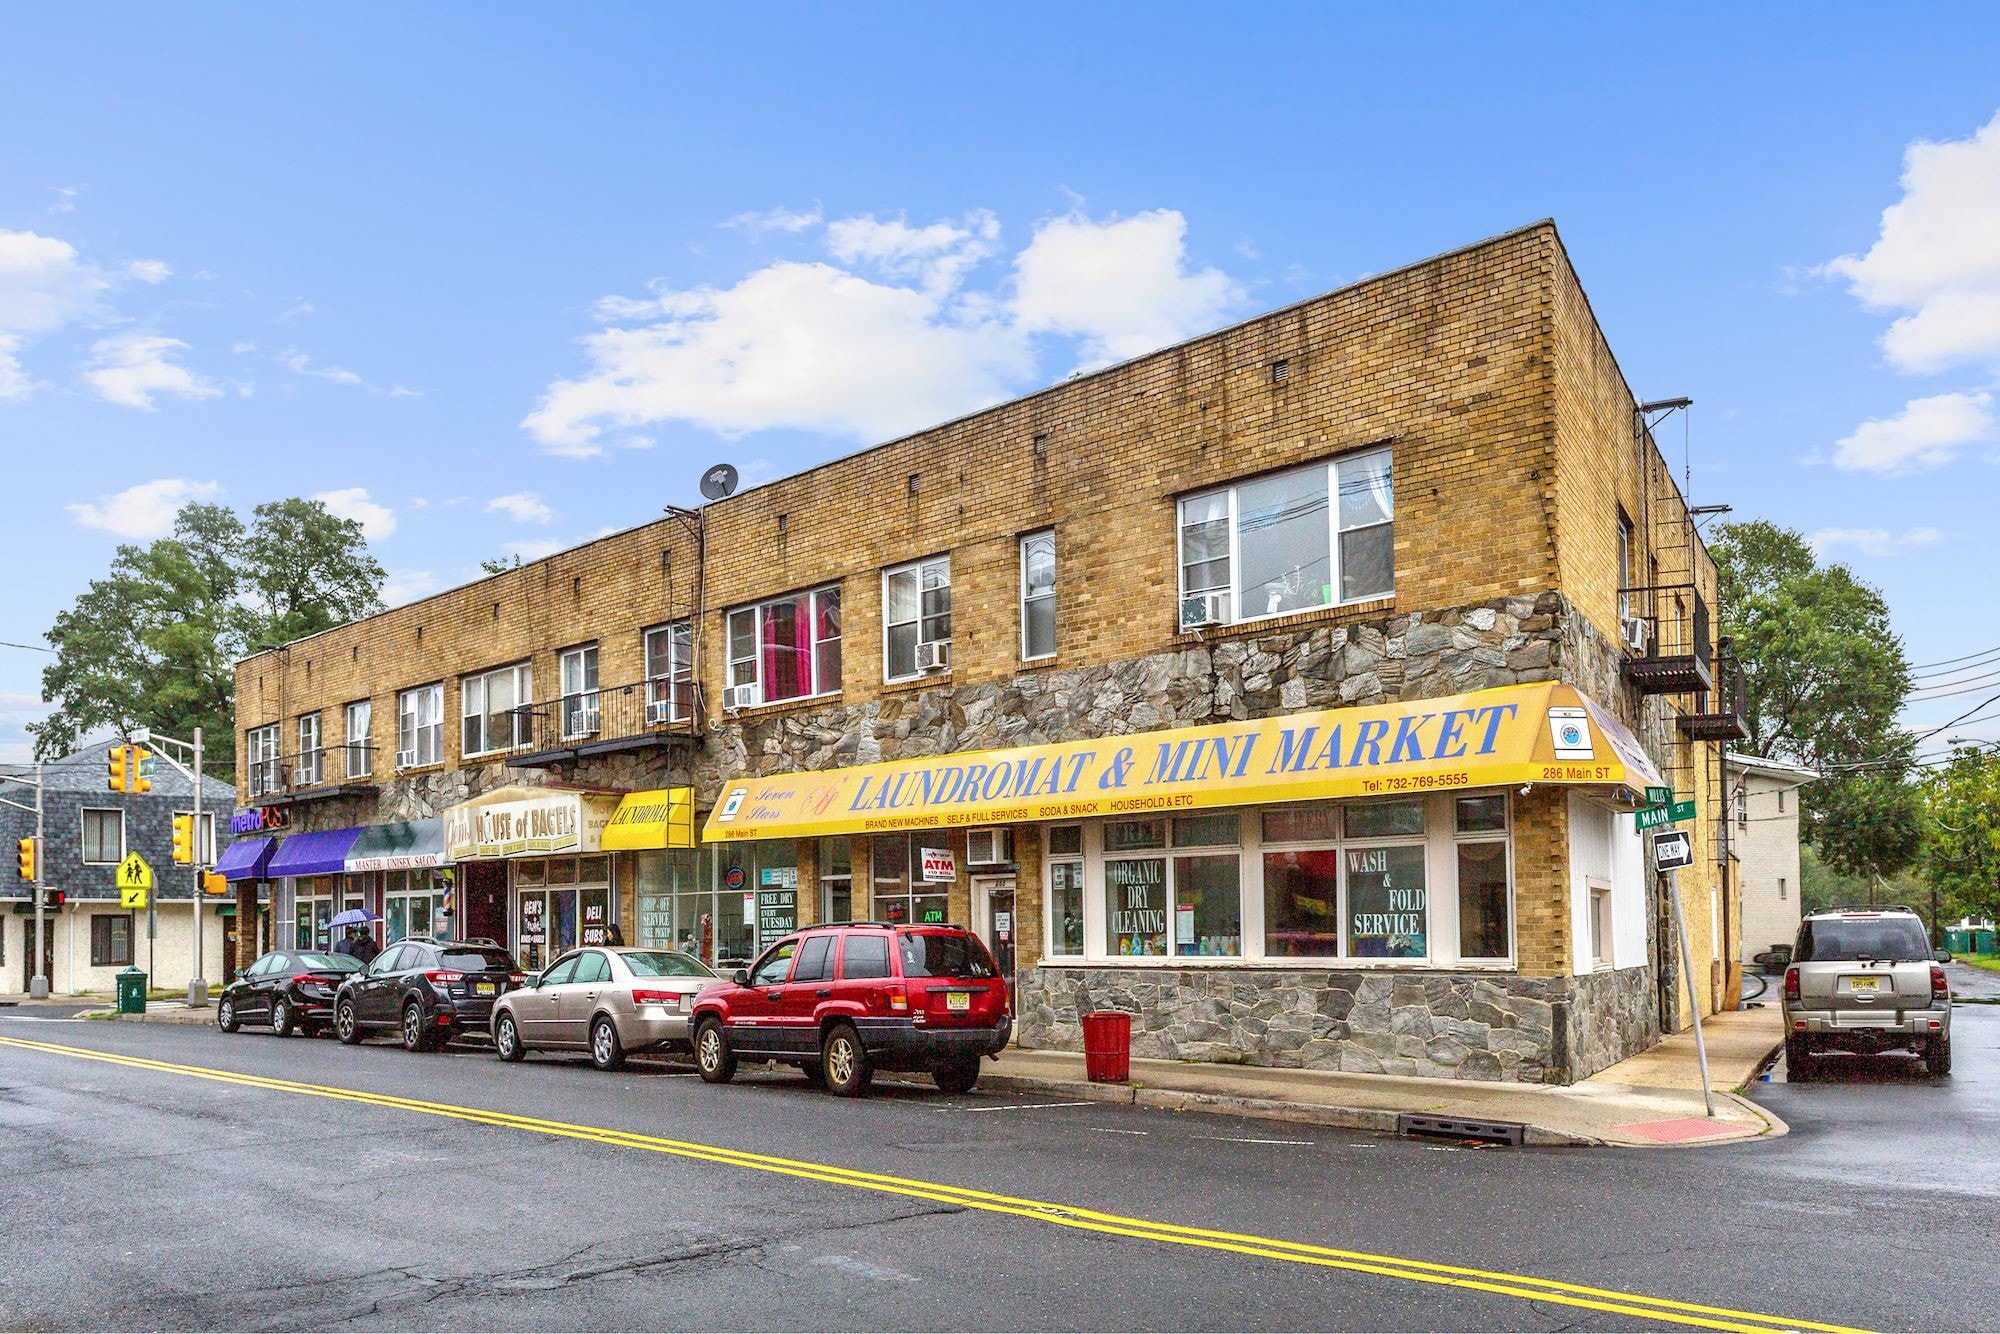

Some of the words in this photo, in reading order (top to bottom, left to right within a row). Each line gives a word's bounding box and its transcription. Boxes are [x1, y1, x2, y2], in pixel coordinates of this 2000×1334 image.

[848, 752, 1097, 811] LAUNDROMAT
[1098, 747, 1135, 789] &
[1144, 733, 1261, 785] MINI
[1265, 704, 1518, 774] MARKET
[1543, 767, 1563, 779] 286
[1567, 767, 1592, 779] Main
[1595, 767, 1611, 779] ST
[1362, 780, 1383, 791] Tel:
[1386, 773, 1468, 790] 732-769-5555
[1039, 806, 1062, 817] SODA
[1063, 805, 1069, 815] &
[1070, 803, 1099, 815] SNACK
[1110, 797, 1165, 811] HOUSEHOLD
[1166, 796, 1173, 807] &
[1175, 794, 1193, 806] ETC
[865, 819, 887, 829] BRAND
[888, 818, 904, 828] NEW
[905, 816, 939, 826] MACHINES
[947, 814, 964, 824] SELF
[965, 813, 970, 823] &
[972, 812, 990, 822] FULL
[991, 808, 1028, 820] SERVICES
[1641, 808, 1669, 826] MAIN
[1676, 804, 1685, 813] ST
[475, 812, 511, 843] HOUSE
[515, 810, 528, 839] of
[531, 804, 576, 837] BAGELS
[725, 830, 735, 839] 286
[735, 829, 749, 838] Main
[749, 829, 757, 837] ST
[1658, 844, 1670, 859] ONE
[1670, 842, 1681, 857] WAY
[355, 859, 382, 870] MASTER
[387, 856, 412, 869] UNISEX
[414, 855, 437, 866] SALON
[925, 859, 954, 871] ATM
[1349, 850, 1388, 872] WASH
[1114, 861, 1161, 885] ORGANIC
[1382, 873, 1391, 888] &
[760, 893, 778, 905] FREE
[780, 892, 794, 904] DRY
[1127, 885, 1149, 909] DRY
[1389, 889, 1425, 911] FOLD
[586, 905, 602, 920] DELI
[643, 912, 670, 926] SERVICE
[924, 911, 943, 922] ATM
[761, 917, 794, 928] TUESDAY
[1112, 910, 1165, 934] CLEANING
[1355, 914, 1419, 935] SERVICE
[584, 929, 604, 943] SUBS
